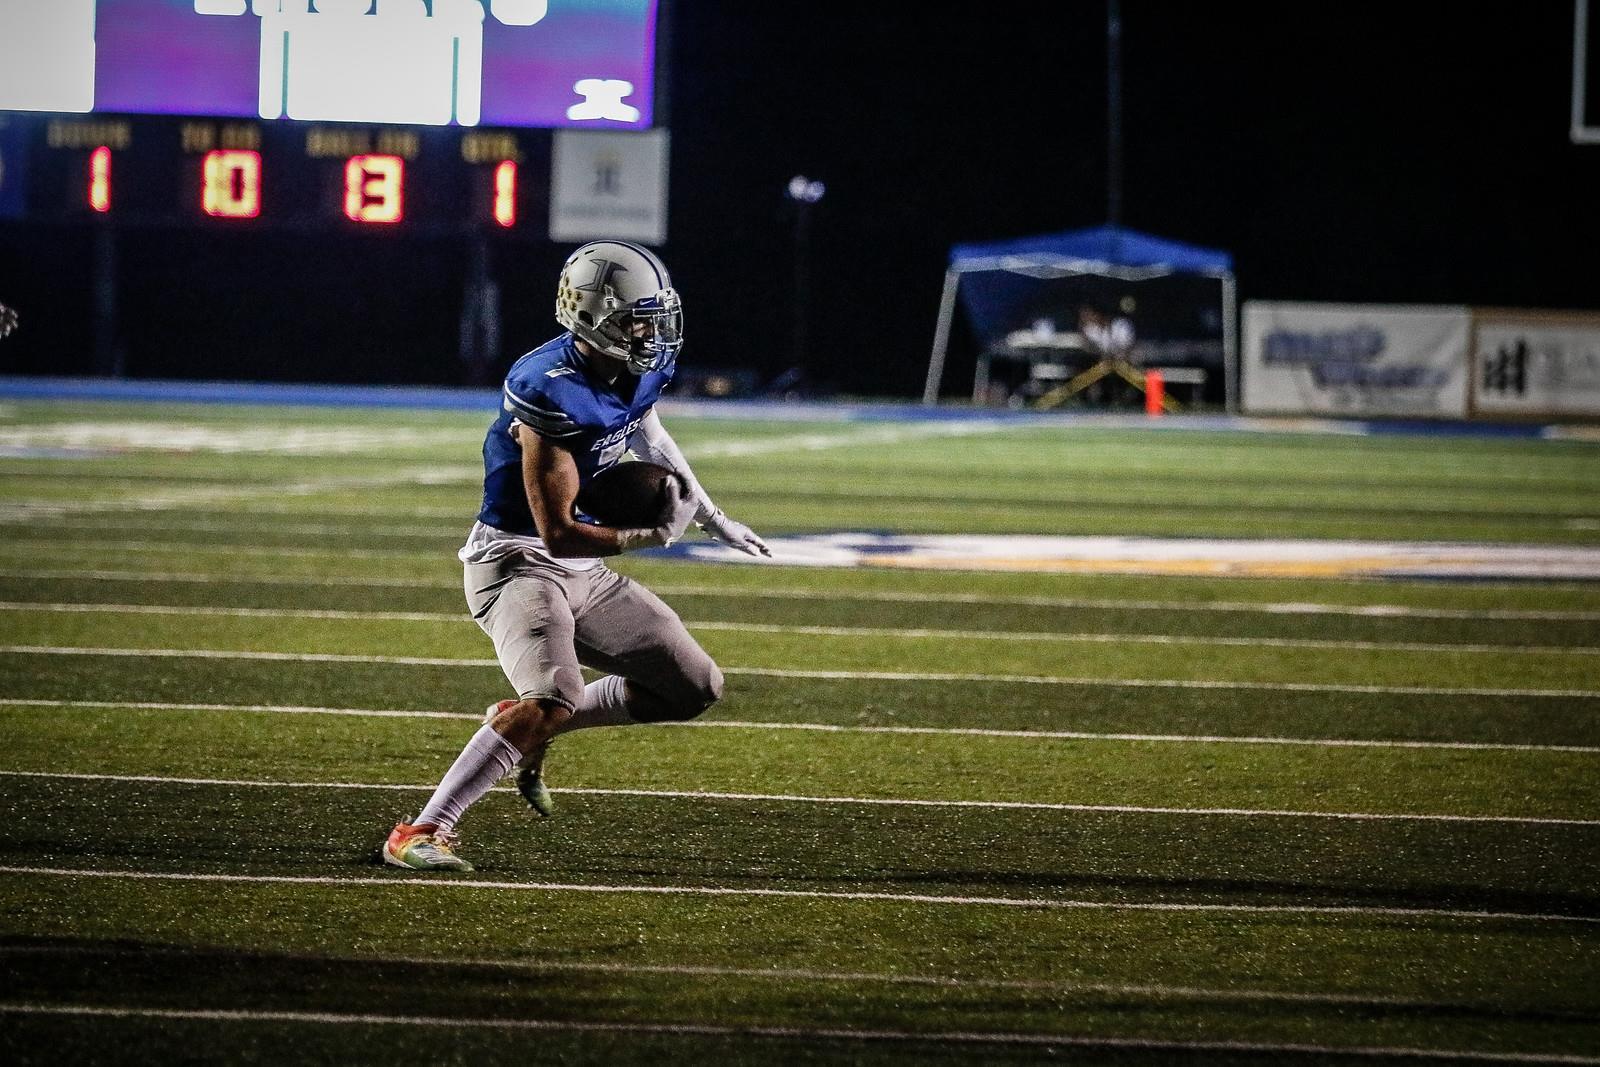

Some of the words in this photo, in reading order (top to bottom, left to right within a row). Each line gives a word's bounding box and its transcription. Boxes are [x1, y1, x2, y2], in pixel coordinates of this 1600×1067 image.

[89, 146, 111, 212] 1
[203, 150, 261, 217] 10
[345, 155, 403, 222] 13
[494, 160, 517, 227] 1
[590, 418, 641, 452] EAGLES
